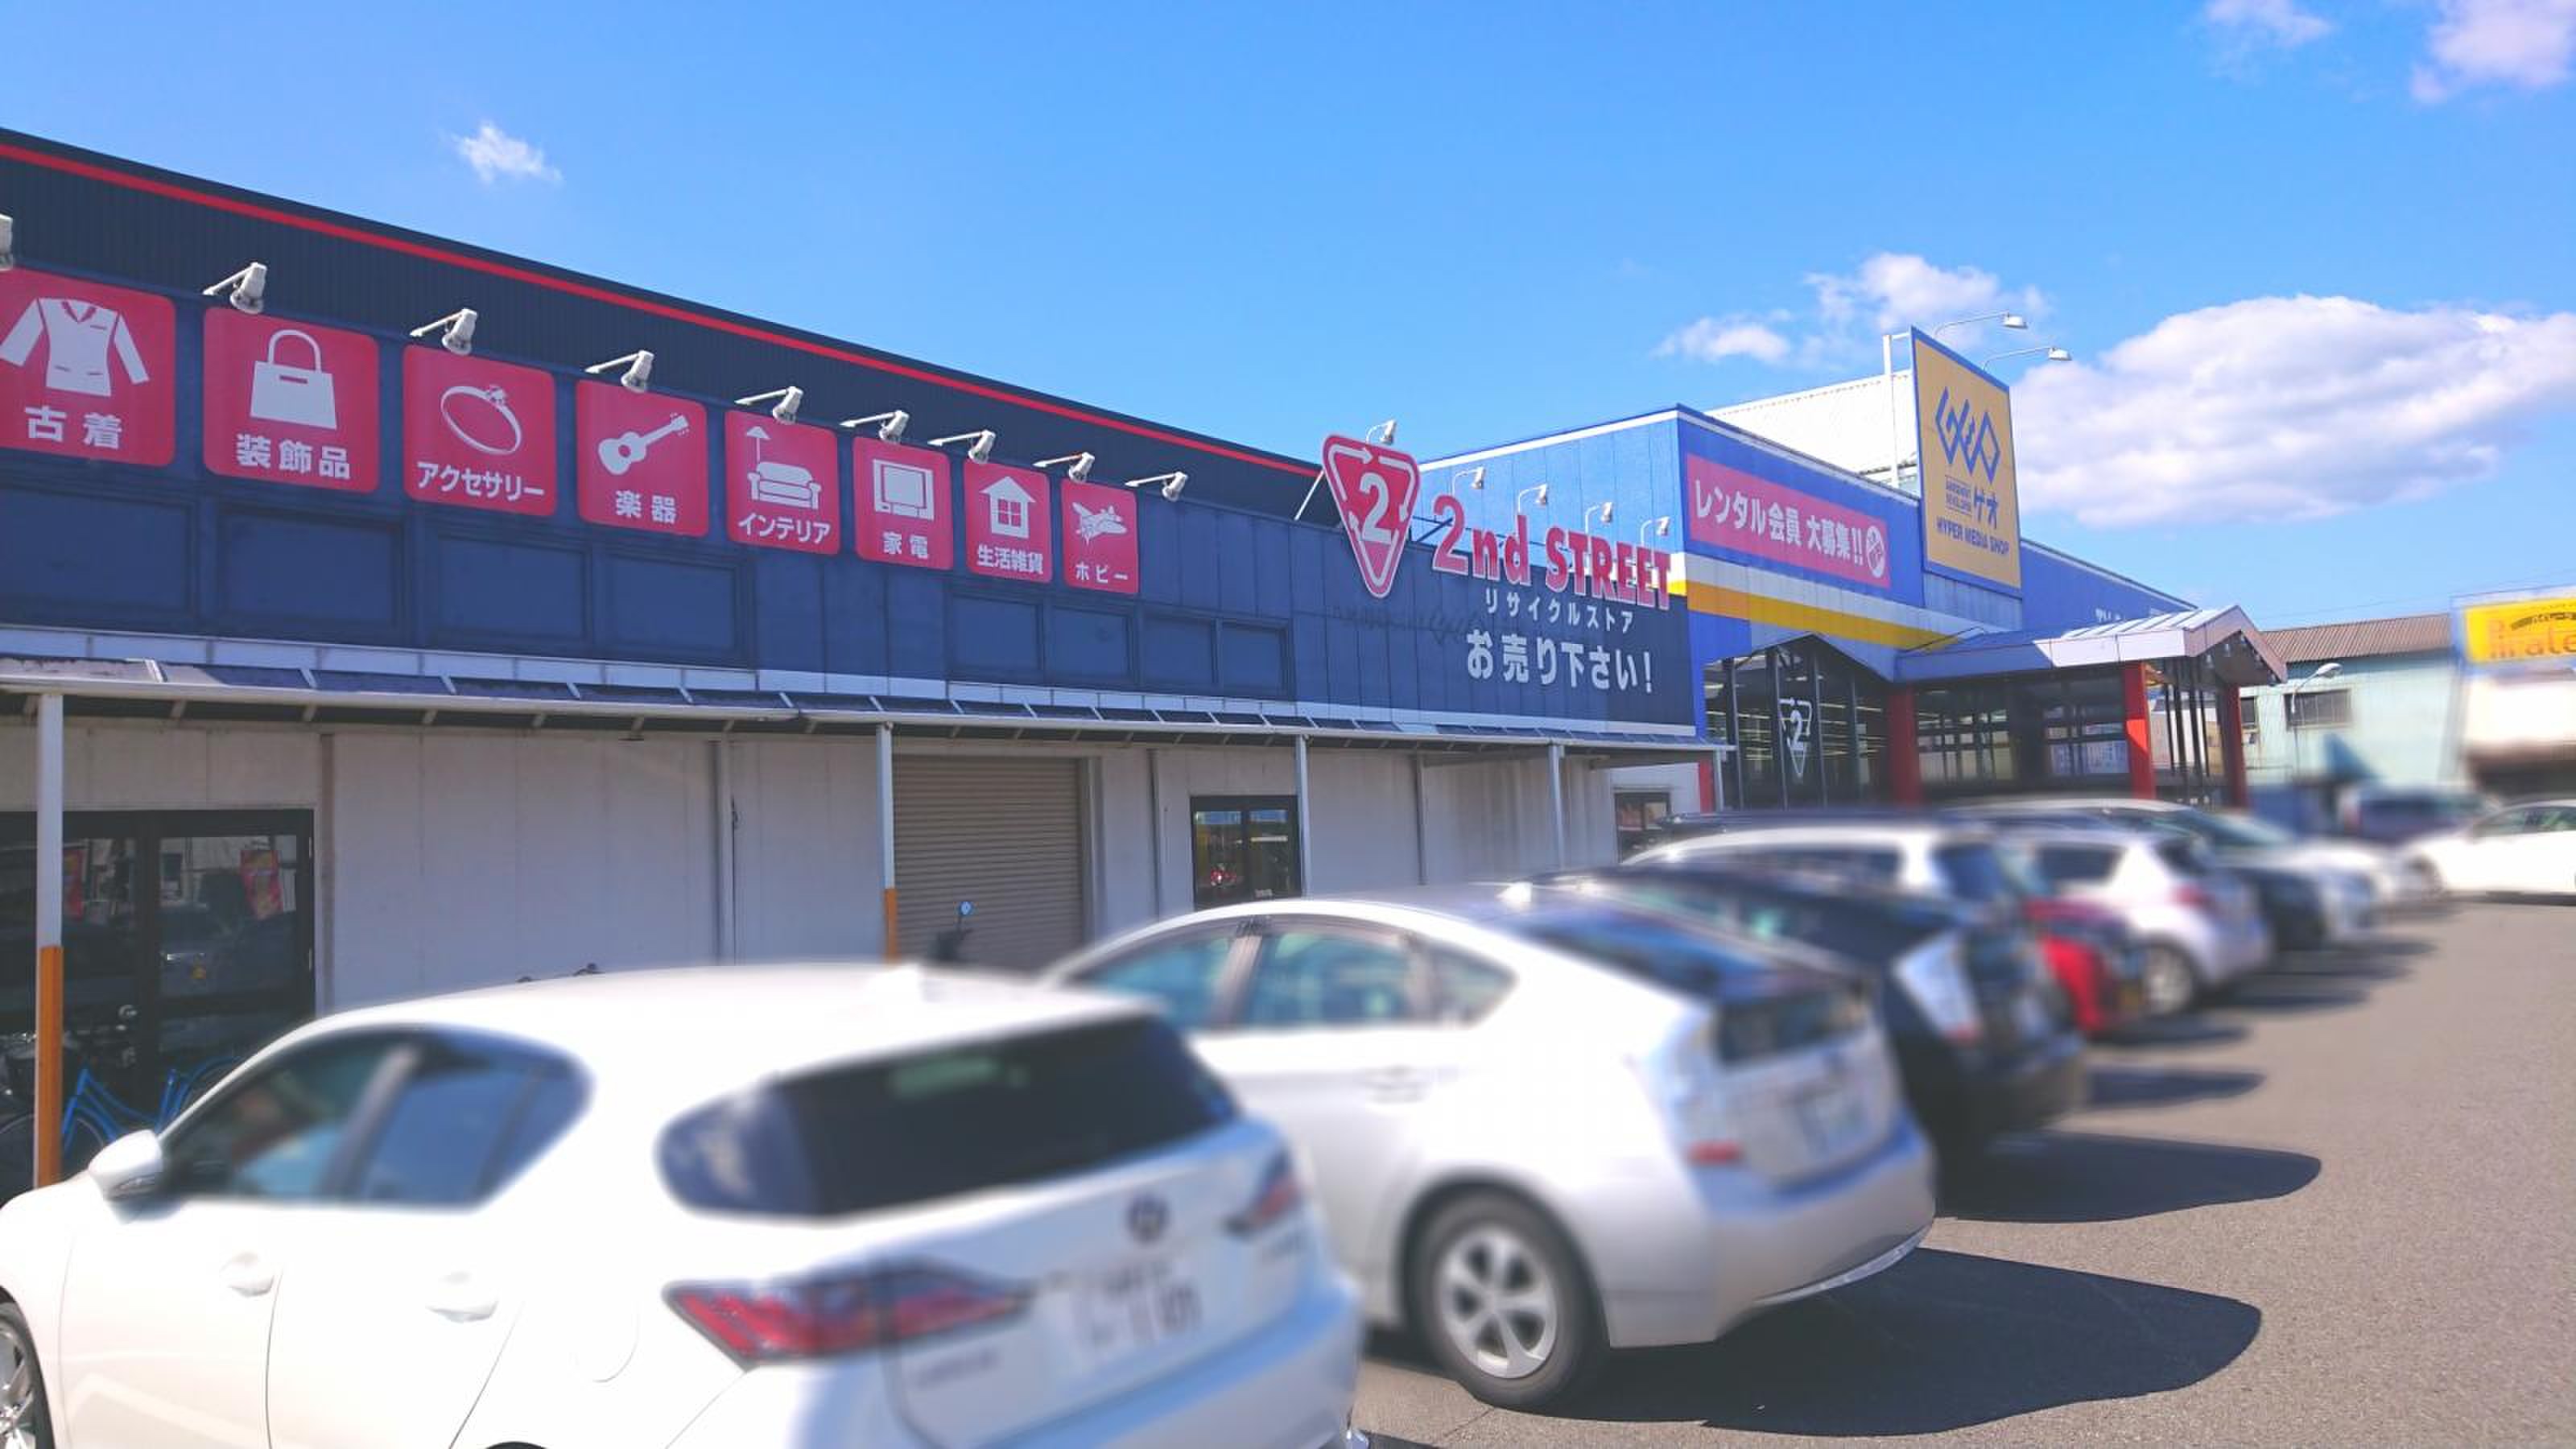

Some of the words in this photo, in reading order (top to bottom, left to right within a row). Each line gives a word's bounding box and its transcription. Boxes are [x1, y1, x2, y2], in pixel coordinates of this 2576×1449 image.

[25, 406, 122, 449] 古着
[236, 433, 351, 480] 装飾品
[416, 462, 545, 502] アクセサリー
[615, 490, 677, 524] 楽器
[1359, 473, 1393, 543] 2
[1695, 479, 1802, 548] レンタル会員
[737, 512, 832, 545] インテリア
[882, 532, 929, 559] 家電
[1936, 517, 1963, 542] HYPER
[1964, 527, 1988, 549] MEDIA
[976, 544, 1044, 575] 生活雑貨
[1432, 495, 1531, 586] 2nd
[1545, 526, 1672, 610] STREET
[1075, 562, 1129, 584] ホビー
[1485, 588, 1634, 634] リサイクルストア
